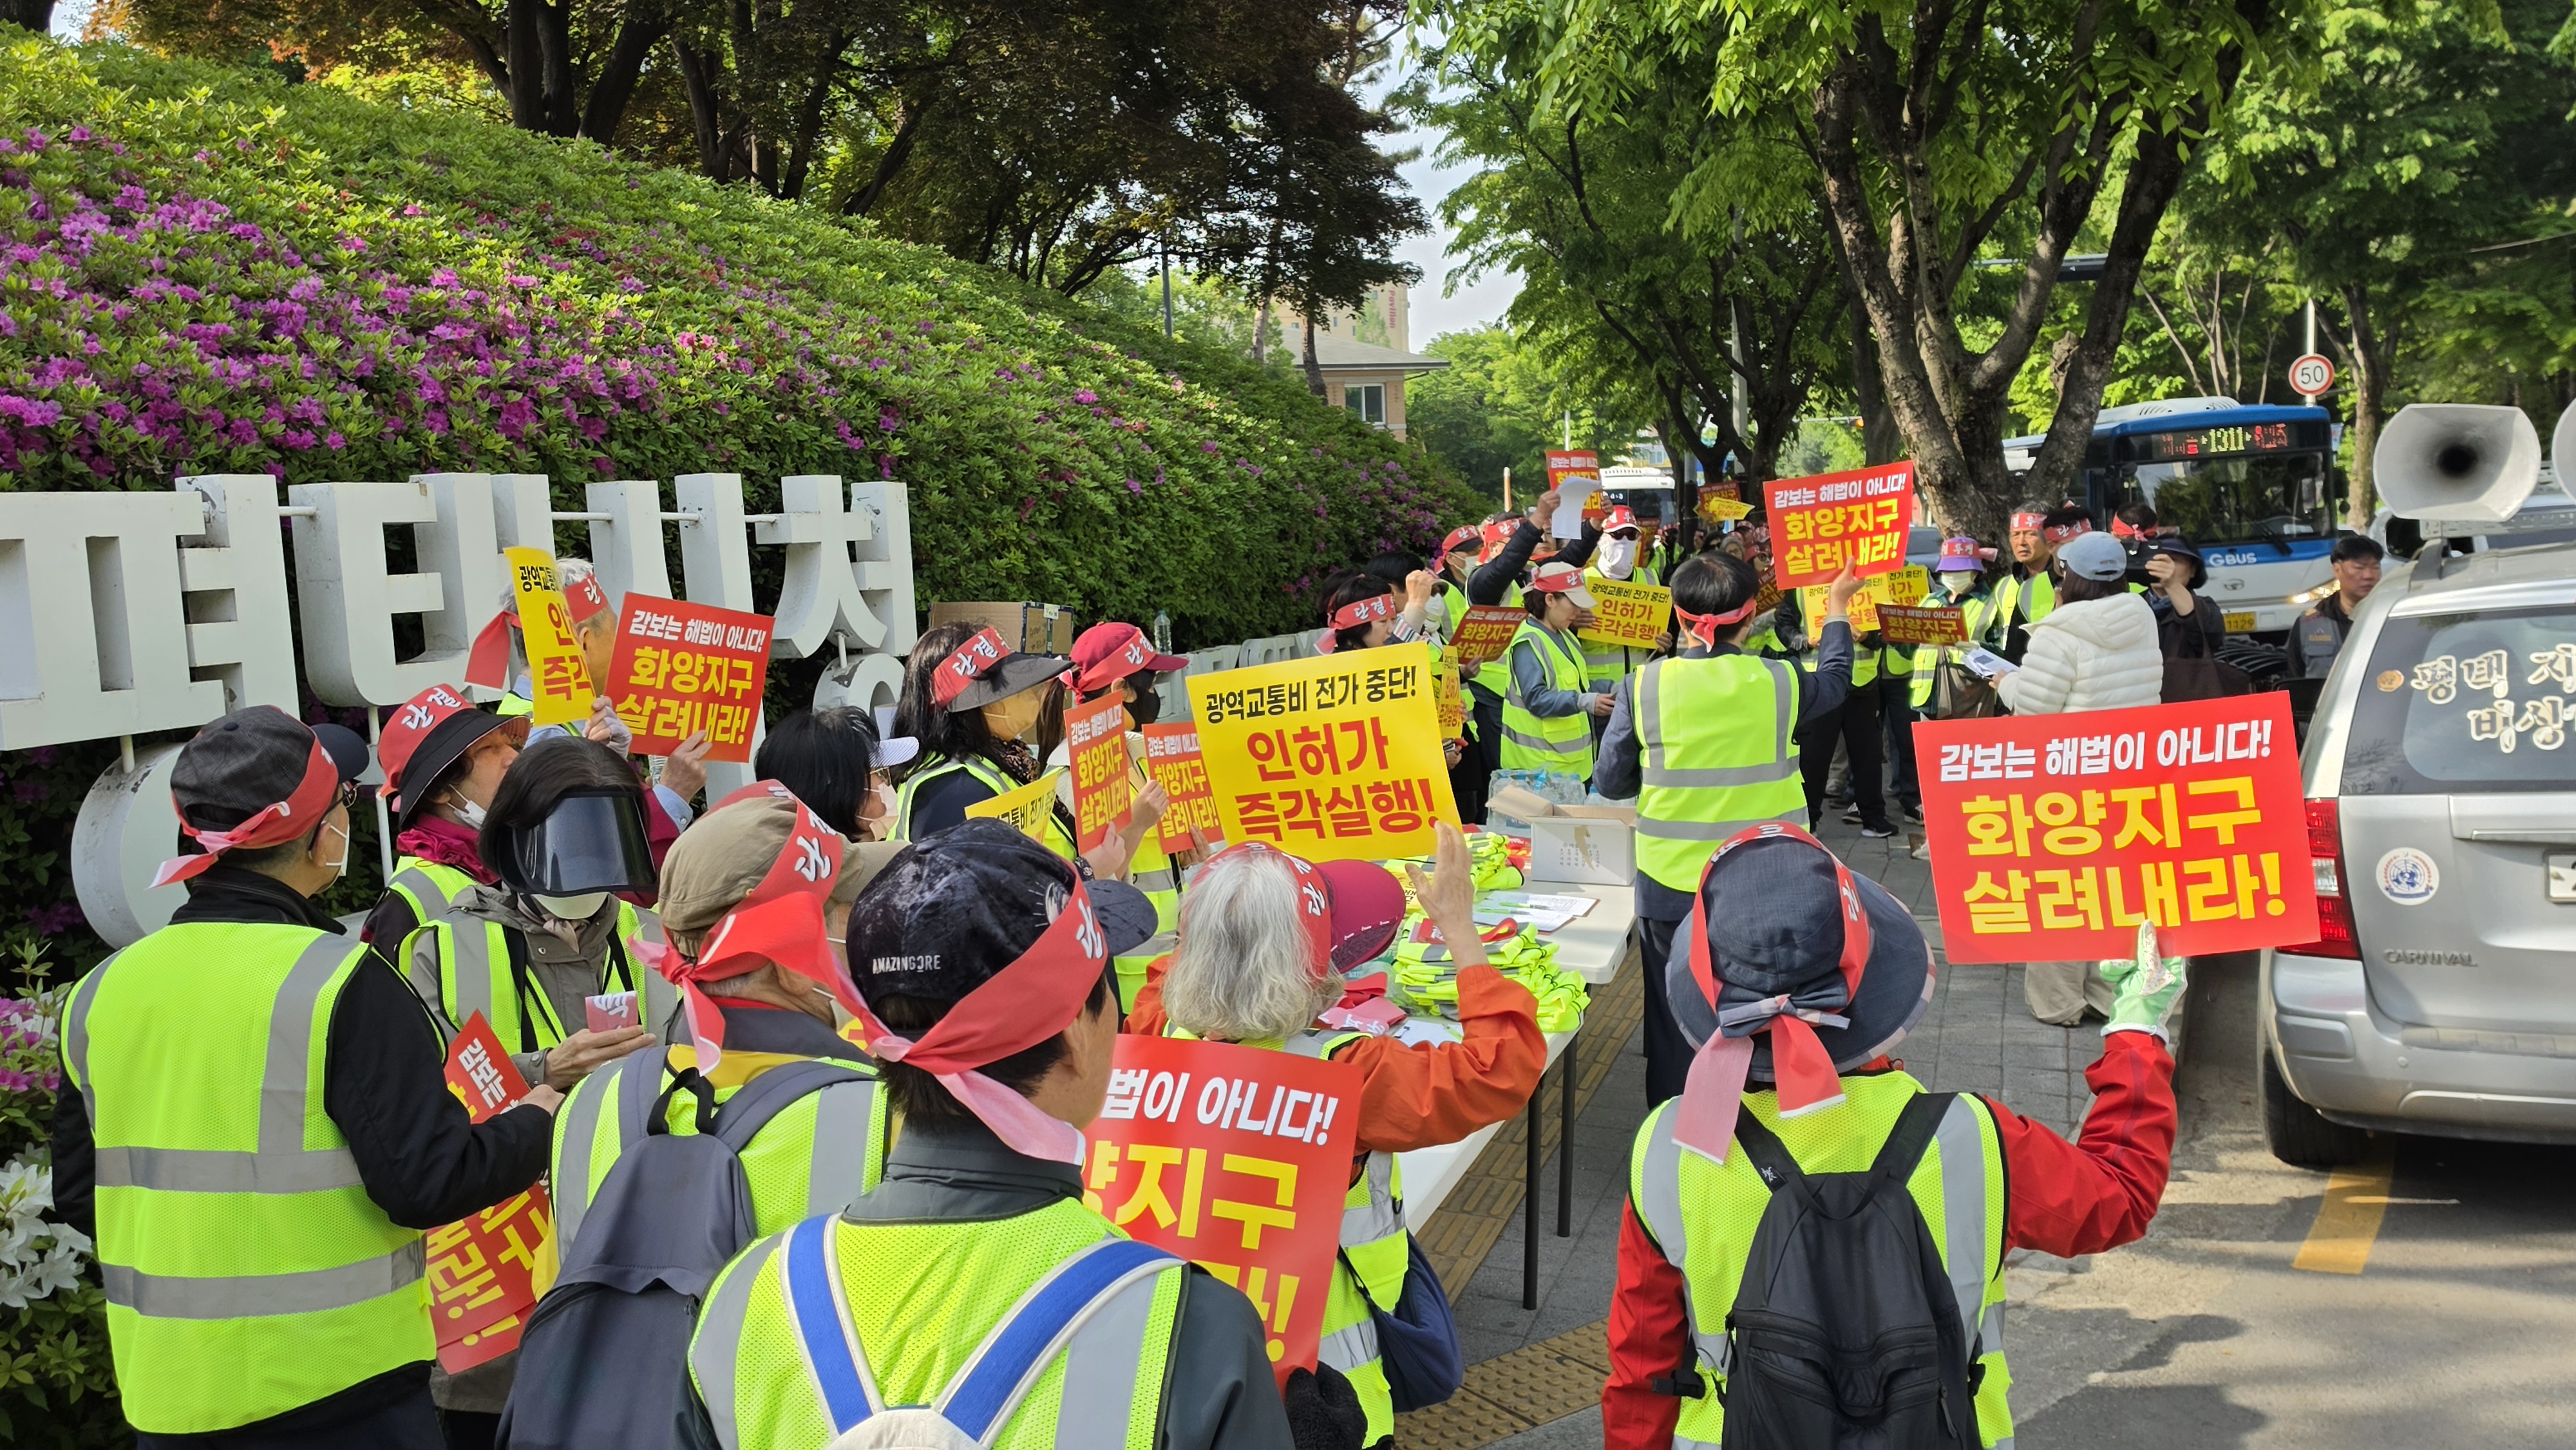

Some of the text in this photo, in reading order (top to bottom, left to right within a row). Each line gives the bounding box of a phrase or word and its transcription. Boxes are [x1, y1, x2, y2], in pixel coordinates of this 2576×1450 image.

[2301, 365, 2324, 384] 50
[2209, 427, 2245, 453] 1311
[1775, 473, 1906, 509] 감보는 해법이 아니다!
[1785, 498, 1899, 540] 화양지구
[1785, 532, 1900, 575] 살려내라!
[1591, 583, 1669, 603] 광역교통비 전가 중단!
[1889, 571, 1904, 580] 전가
[629, 610, 764, 653] 감보는 해법이 아니다!
[1602, 599, 1654, 622] 인허가
[1887, 616, 1958, 633] 화양지구
[1460, 623, 1516, 641] 화양지구
[629, 646, 753, 699] 화양지구
[1206, 680, 1307, 724] 광역교통비
[1316, 673, 1359, 710] 전가
[1365, 665, 1417, 702] 중단!
[616, 694, 750, 745] 살려내라!
[1071, 719, 1091, 746] 감보는
[1091, 710, 1107, 737] 해법이
[1077, 735, 1123, 789] 화양지구
[1148, 737, 1164, 758] 감보는
[1164, 735, 1182, 755] 해법이
[1247, 717, 1390, 782] 인허가
[1940, 720, 2272, 782] 감보는 해법이 아니다!
[1155, 759, 1206, 797] 화양지구
[1080, 776, 1128, 836] 살려내라!
[1160, 796, 1219, 838] 살려내라!
[1235, 778, 1439, 842] 즉각실행!
[1961, 776, 2261, 858] 화양지구
[1964, 852, 2286, 934] 살려내라!
[2384, 948, 2478, 967] CARNIVAL
[458, 1037, 507, 1109] 감보는
[1197, 1077, 1338, 1146] 아니다!
